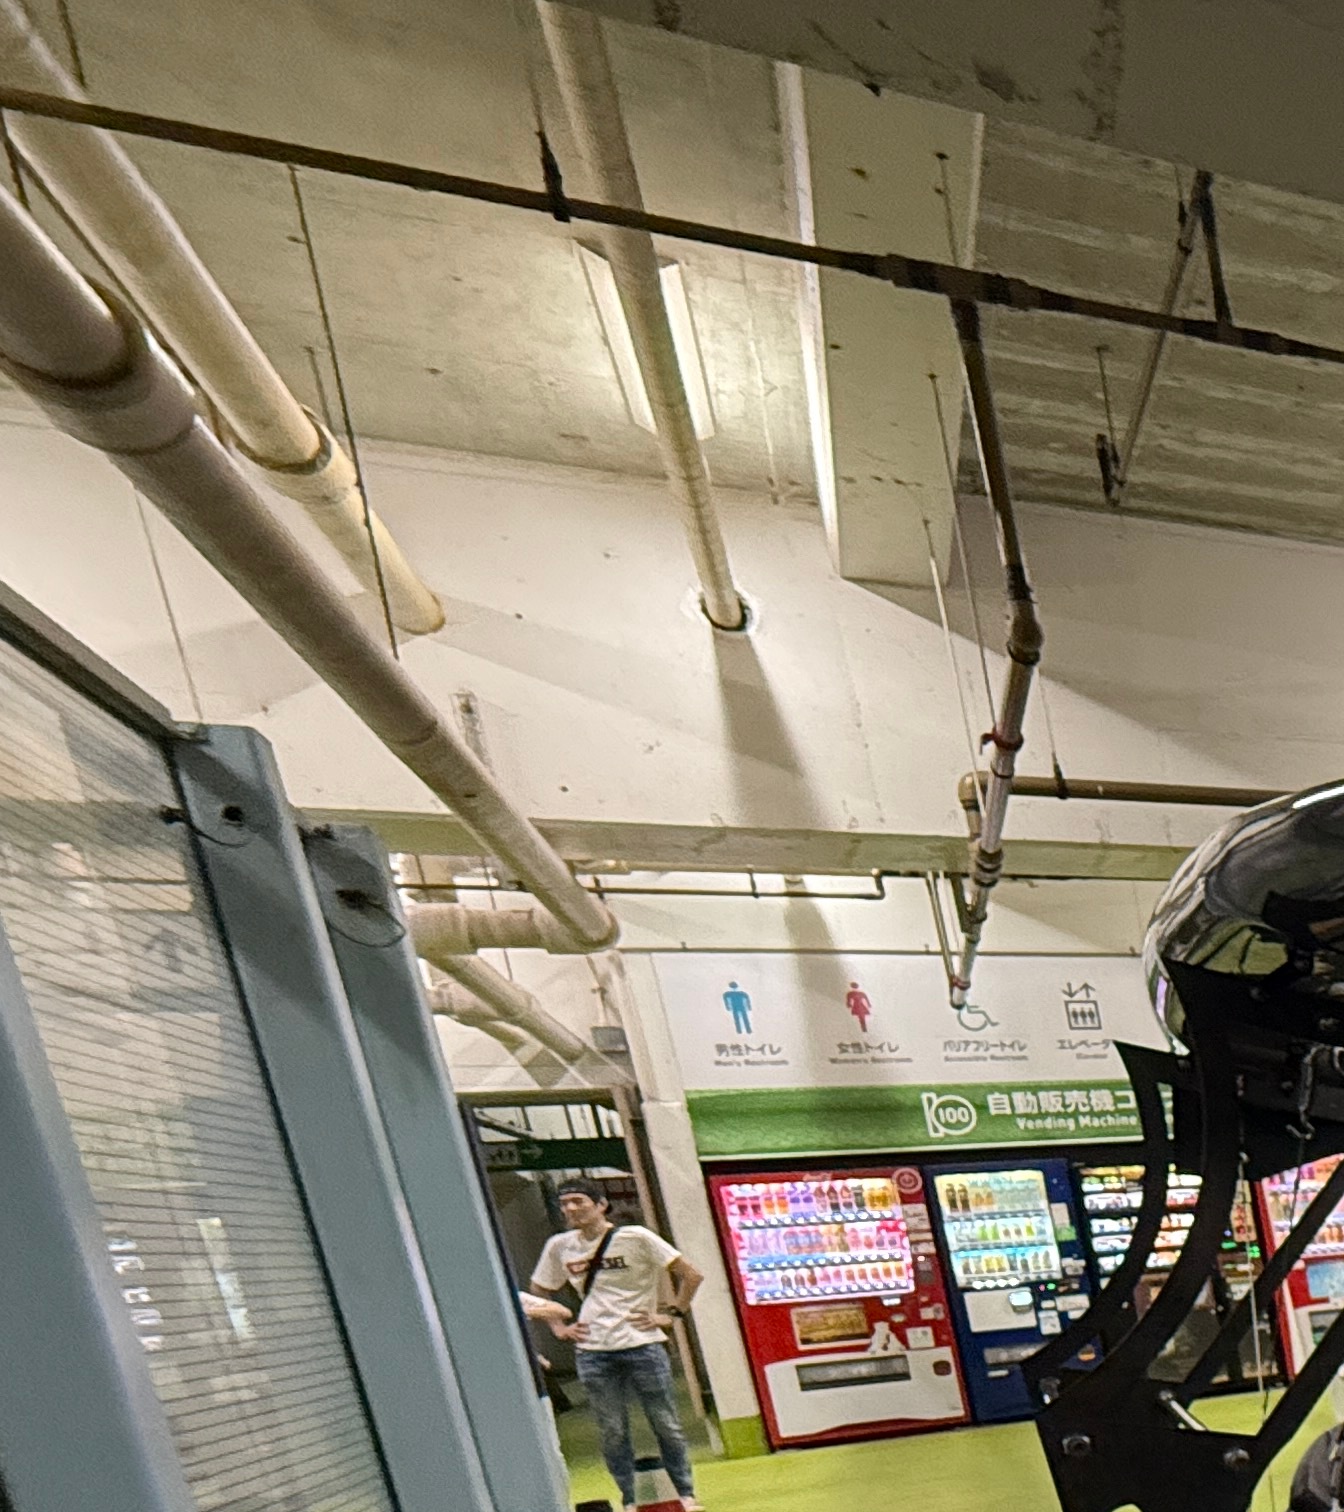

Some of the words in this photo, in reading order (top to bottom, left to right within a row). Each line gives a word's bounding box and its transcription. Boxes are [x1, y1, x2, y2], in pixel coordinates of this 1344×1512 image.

[937, 1107, 969, 1124] 100
[1016, 1116, 1076, 1131] Vending
[1079, 1114, 1138, 1129] Machine
